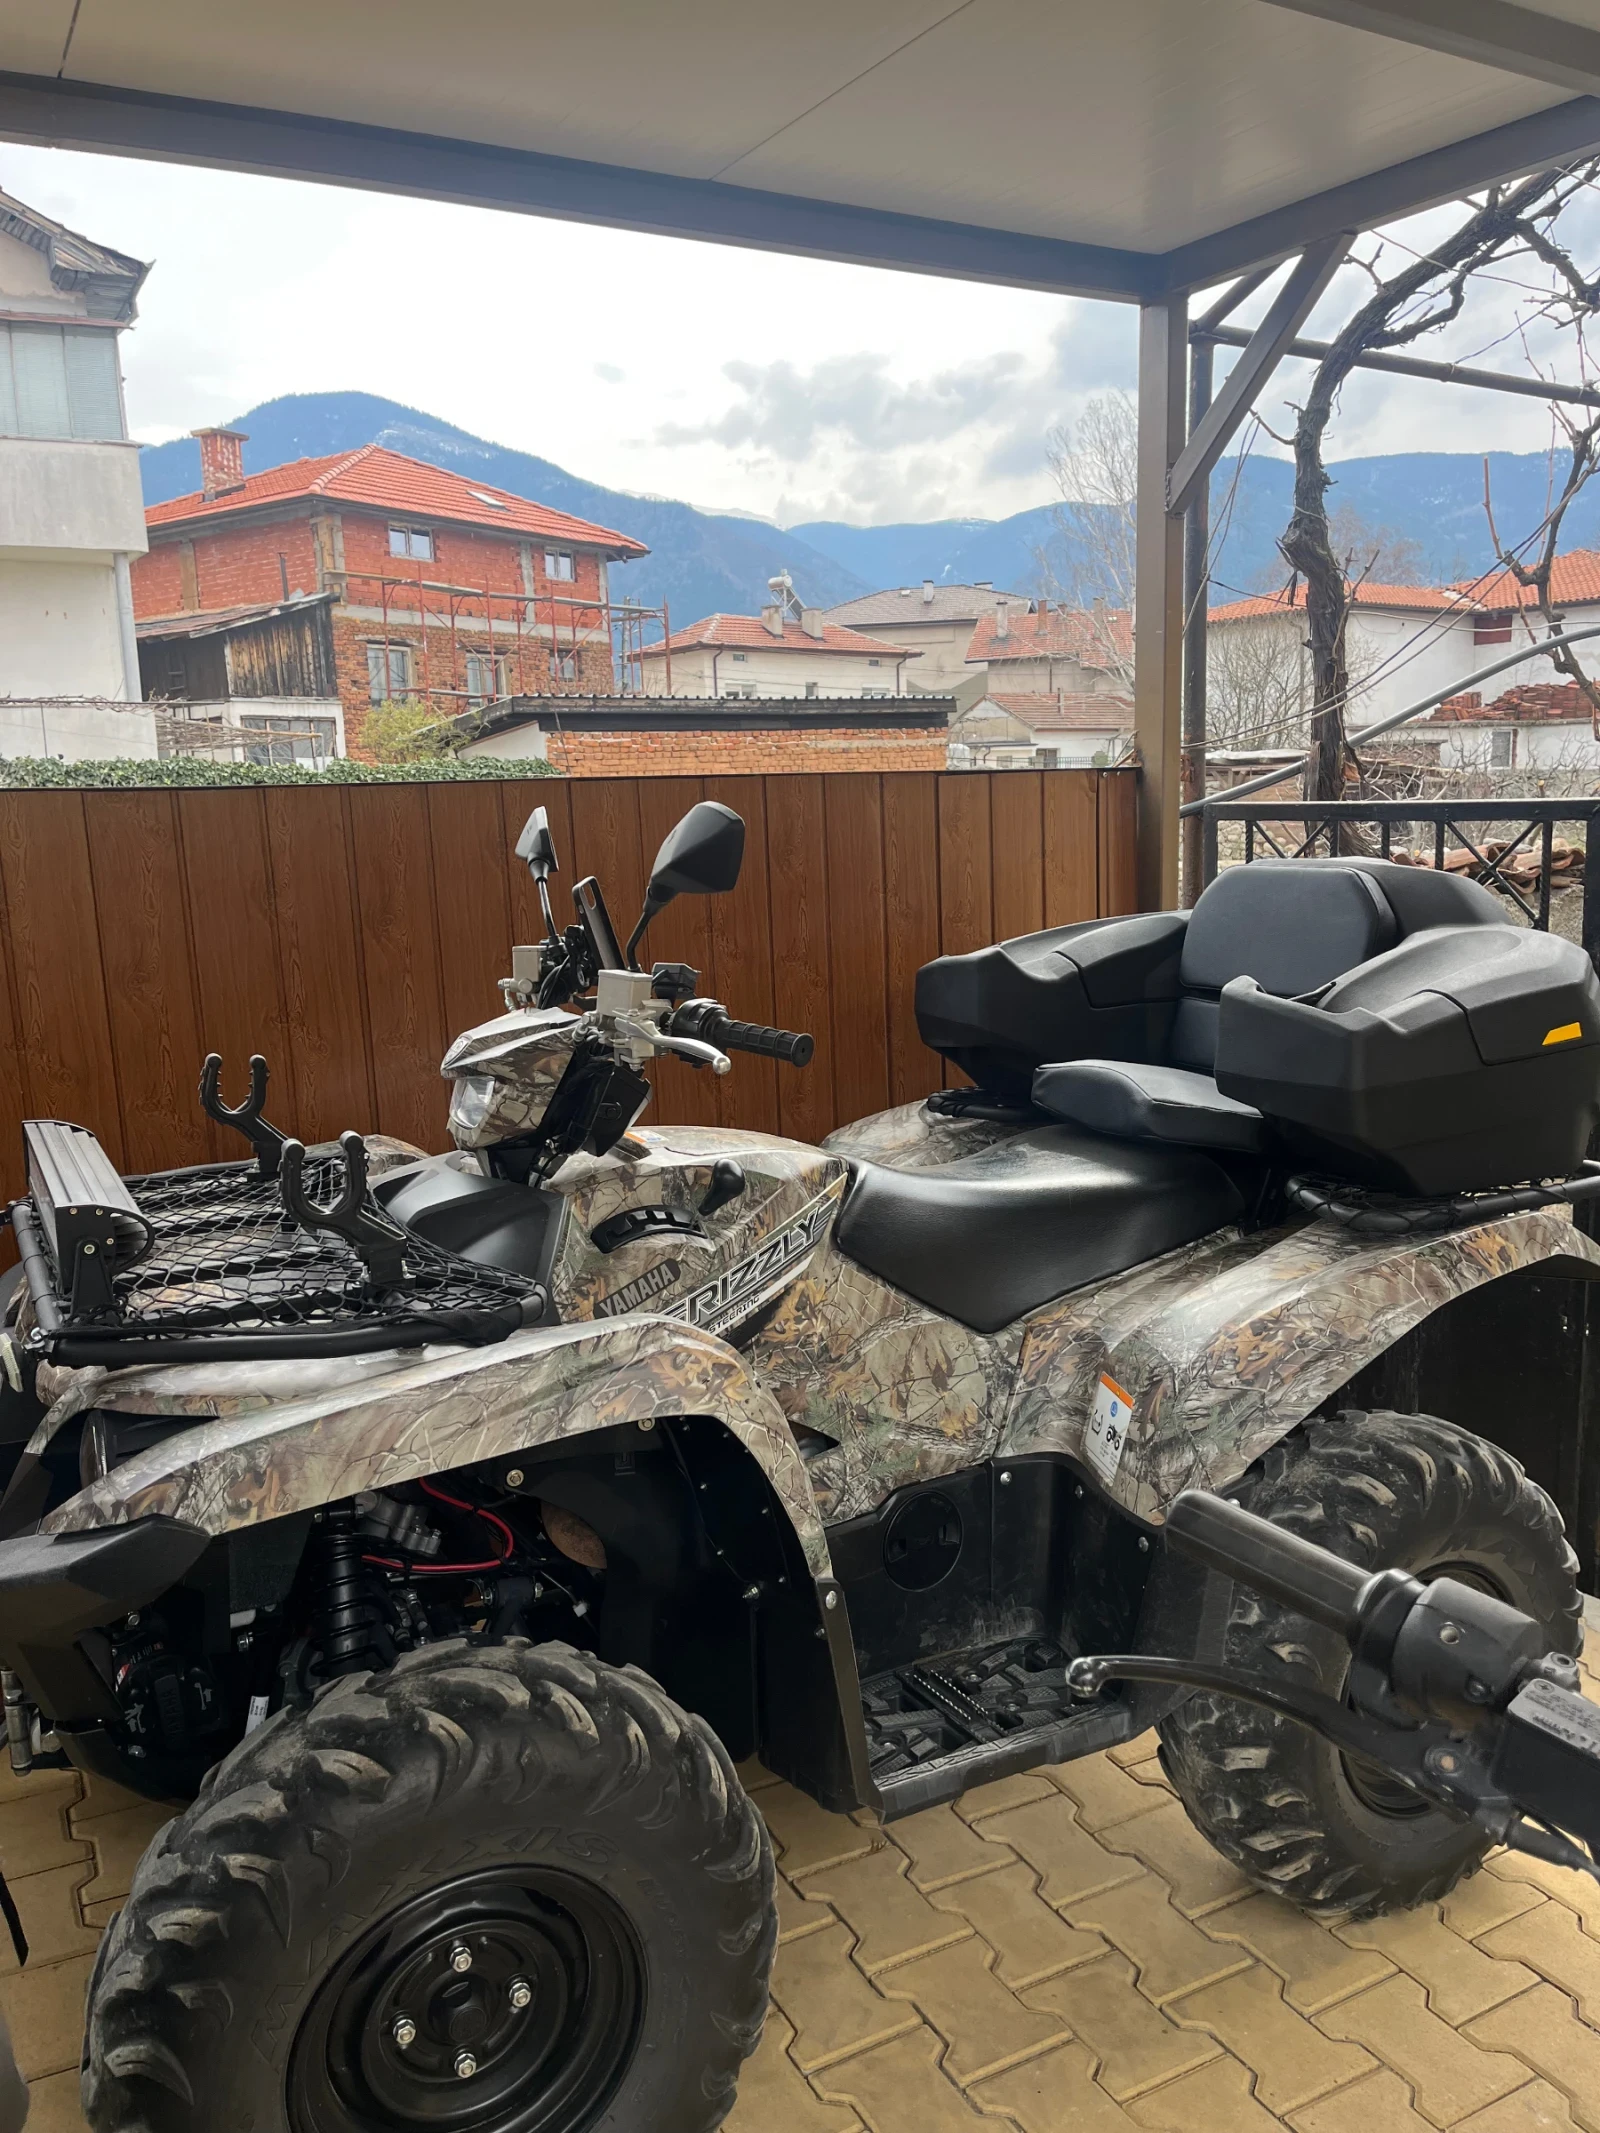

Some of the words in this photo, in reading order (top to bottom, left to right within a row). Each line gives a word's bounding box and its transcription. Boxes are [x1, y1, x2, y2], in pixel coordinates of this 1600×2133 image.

[600, 1264, 676, 1317] YAMAHA
[707, 1293, 762, 1334] STEERING
[250, 1826, 620, 2072] MAXXIS
